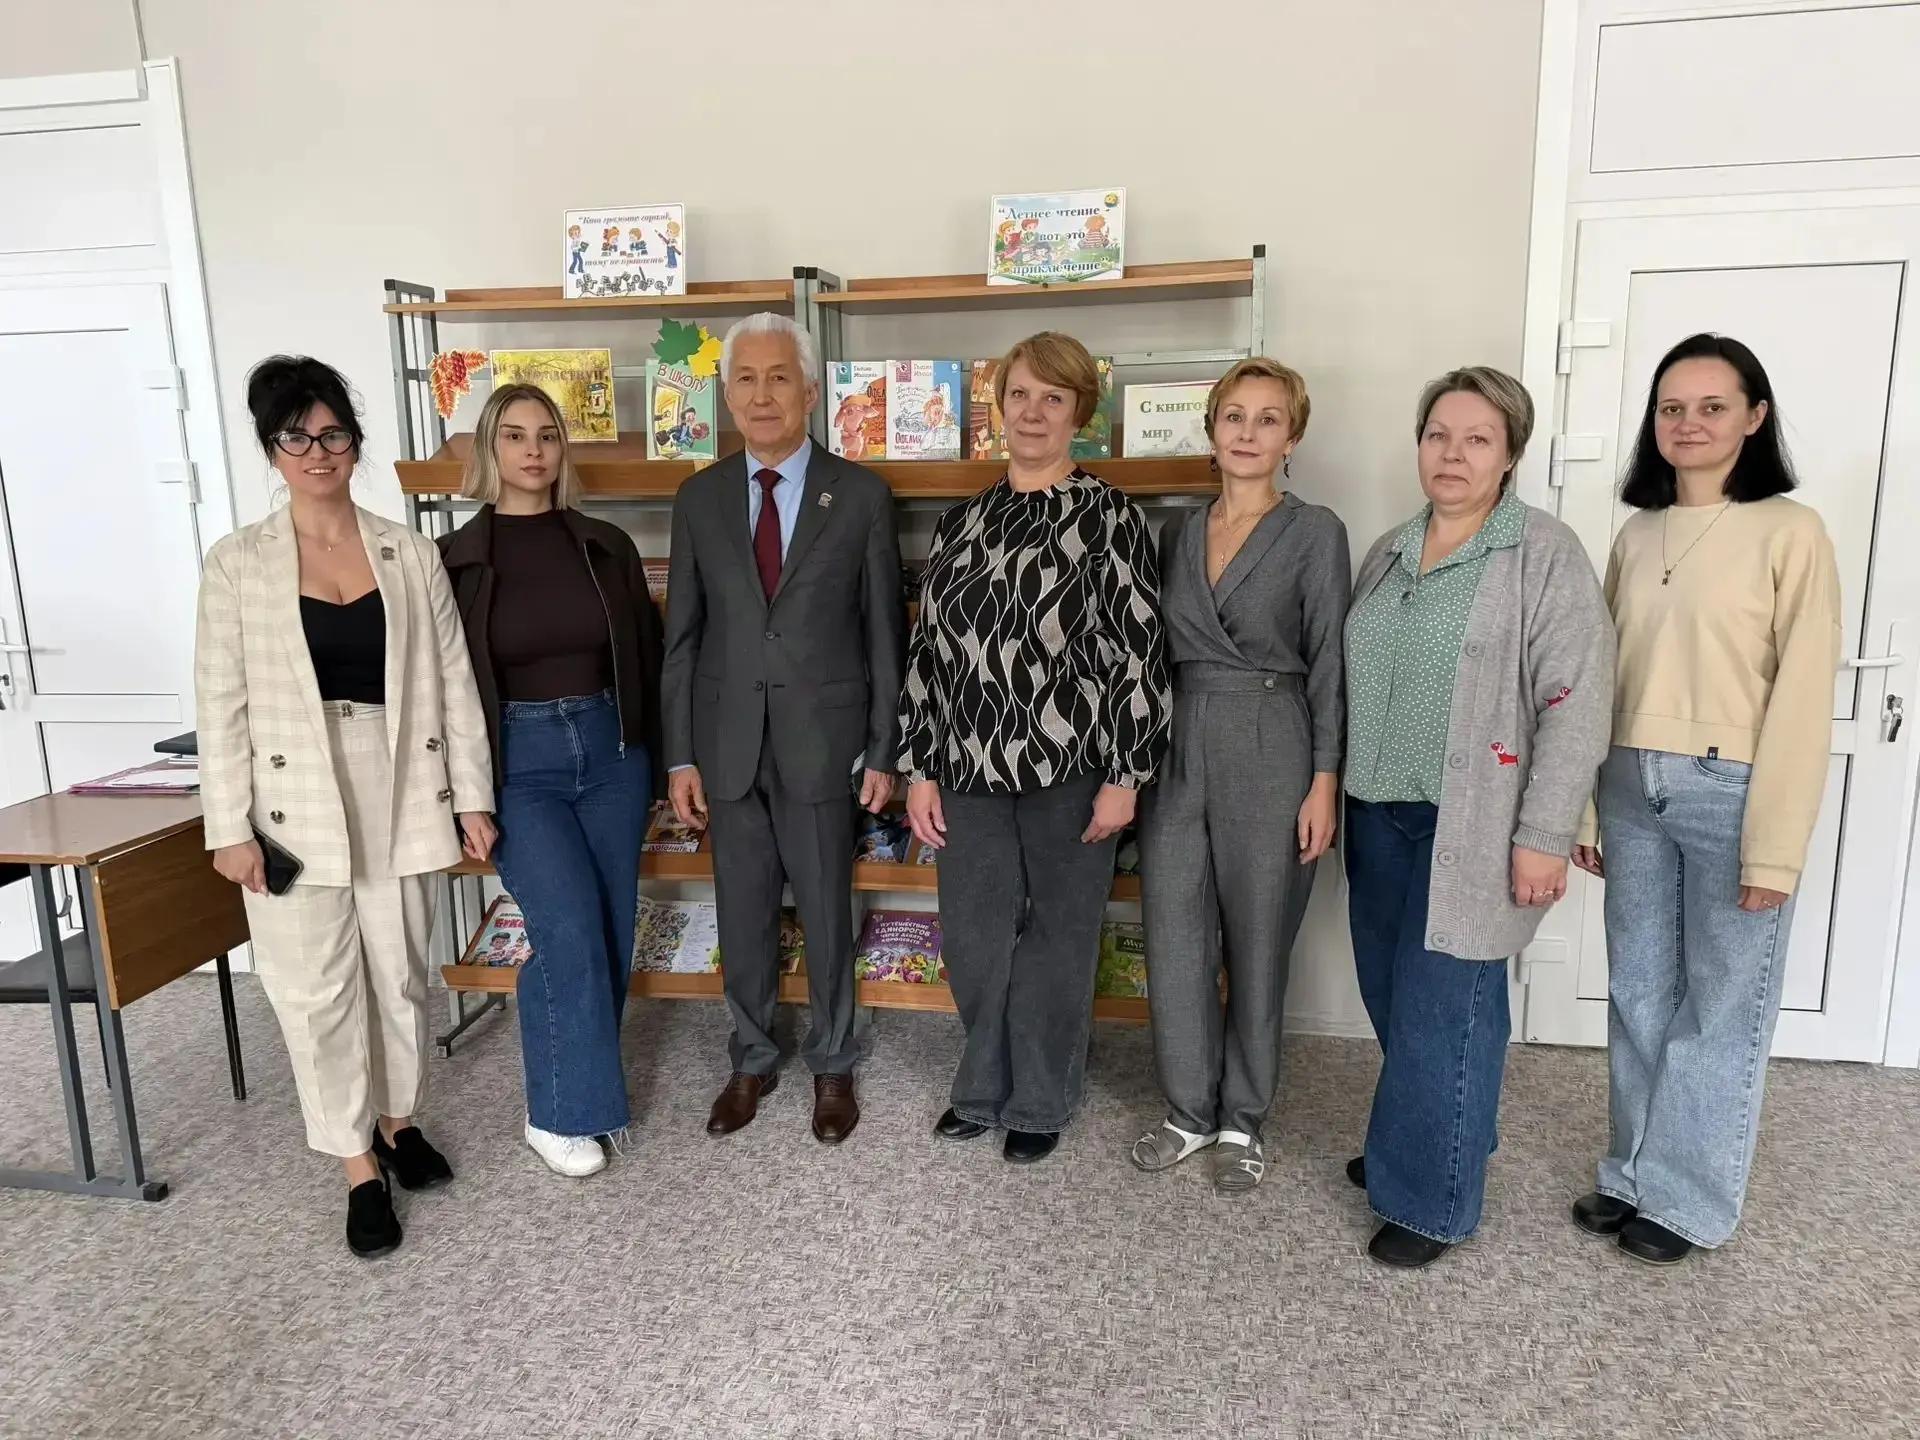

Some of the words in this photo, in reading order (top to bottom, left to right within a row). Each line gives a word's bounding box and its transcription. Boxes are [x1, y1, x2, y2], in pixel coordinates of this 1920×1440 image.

[1056, 207, 1100, 217] чтение
[1040, 232, 1059, 241] вот
[1066, 231, 1085, 240] это
[657, 364, 667, 377] В
[669, 368, 708, 393] ШКОЛУ
[1140, 401, 1152, 414] С
[1141, 429, 1173, 443] мир
[875, 926, 931, 937] ЕДИНОРОГОВ
